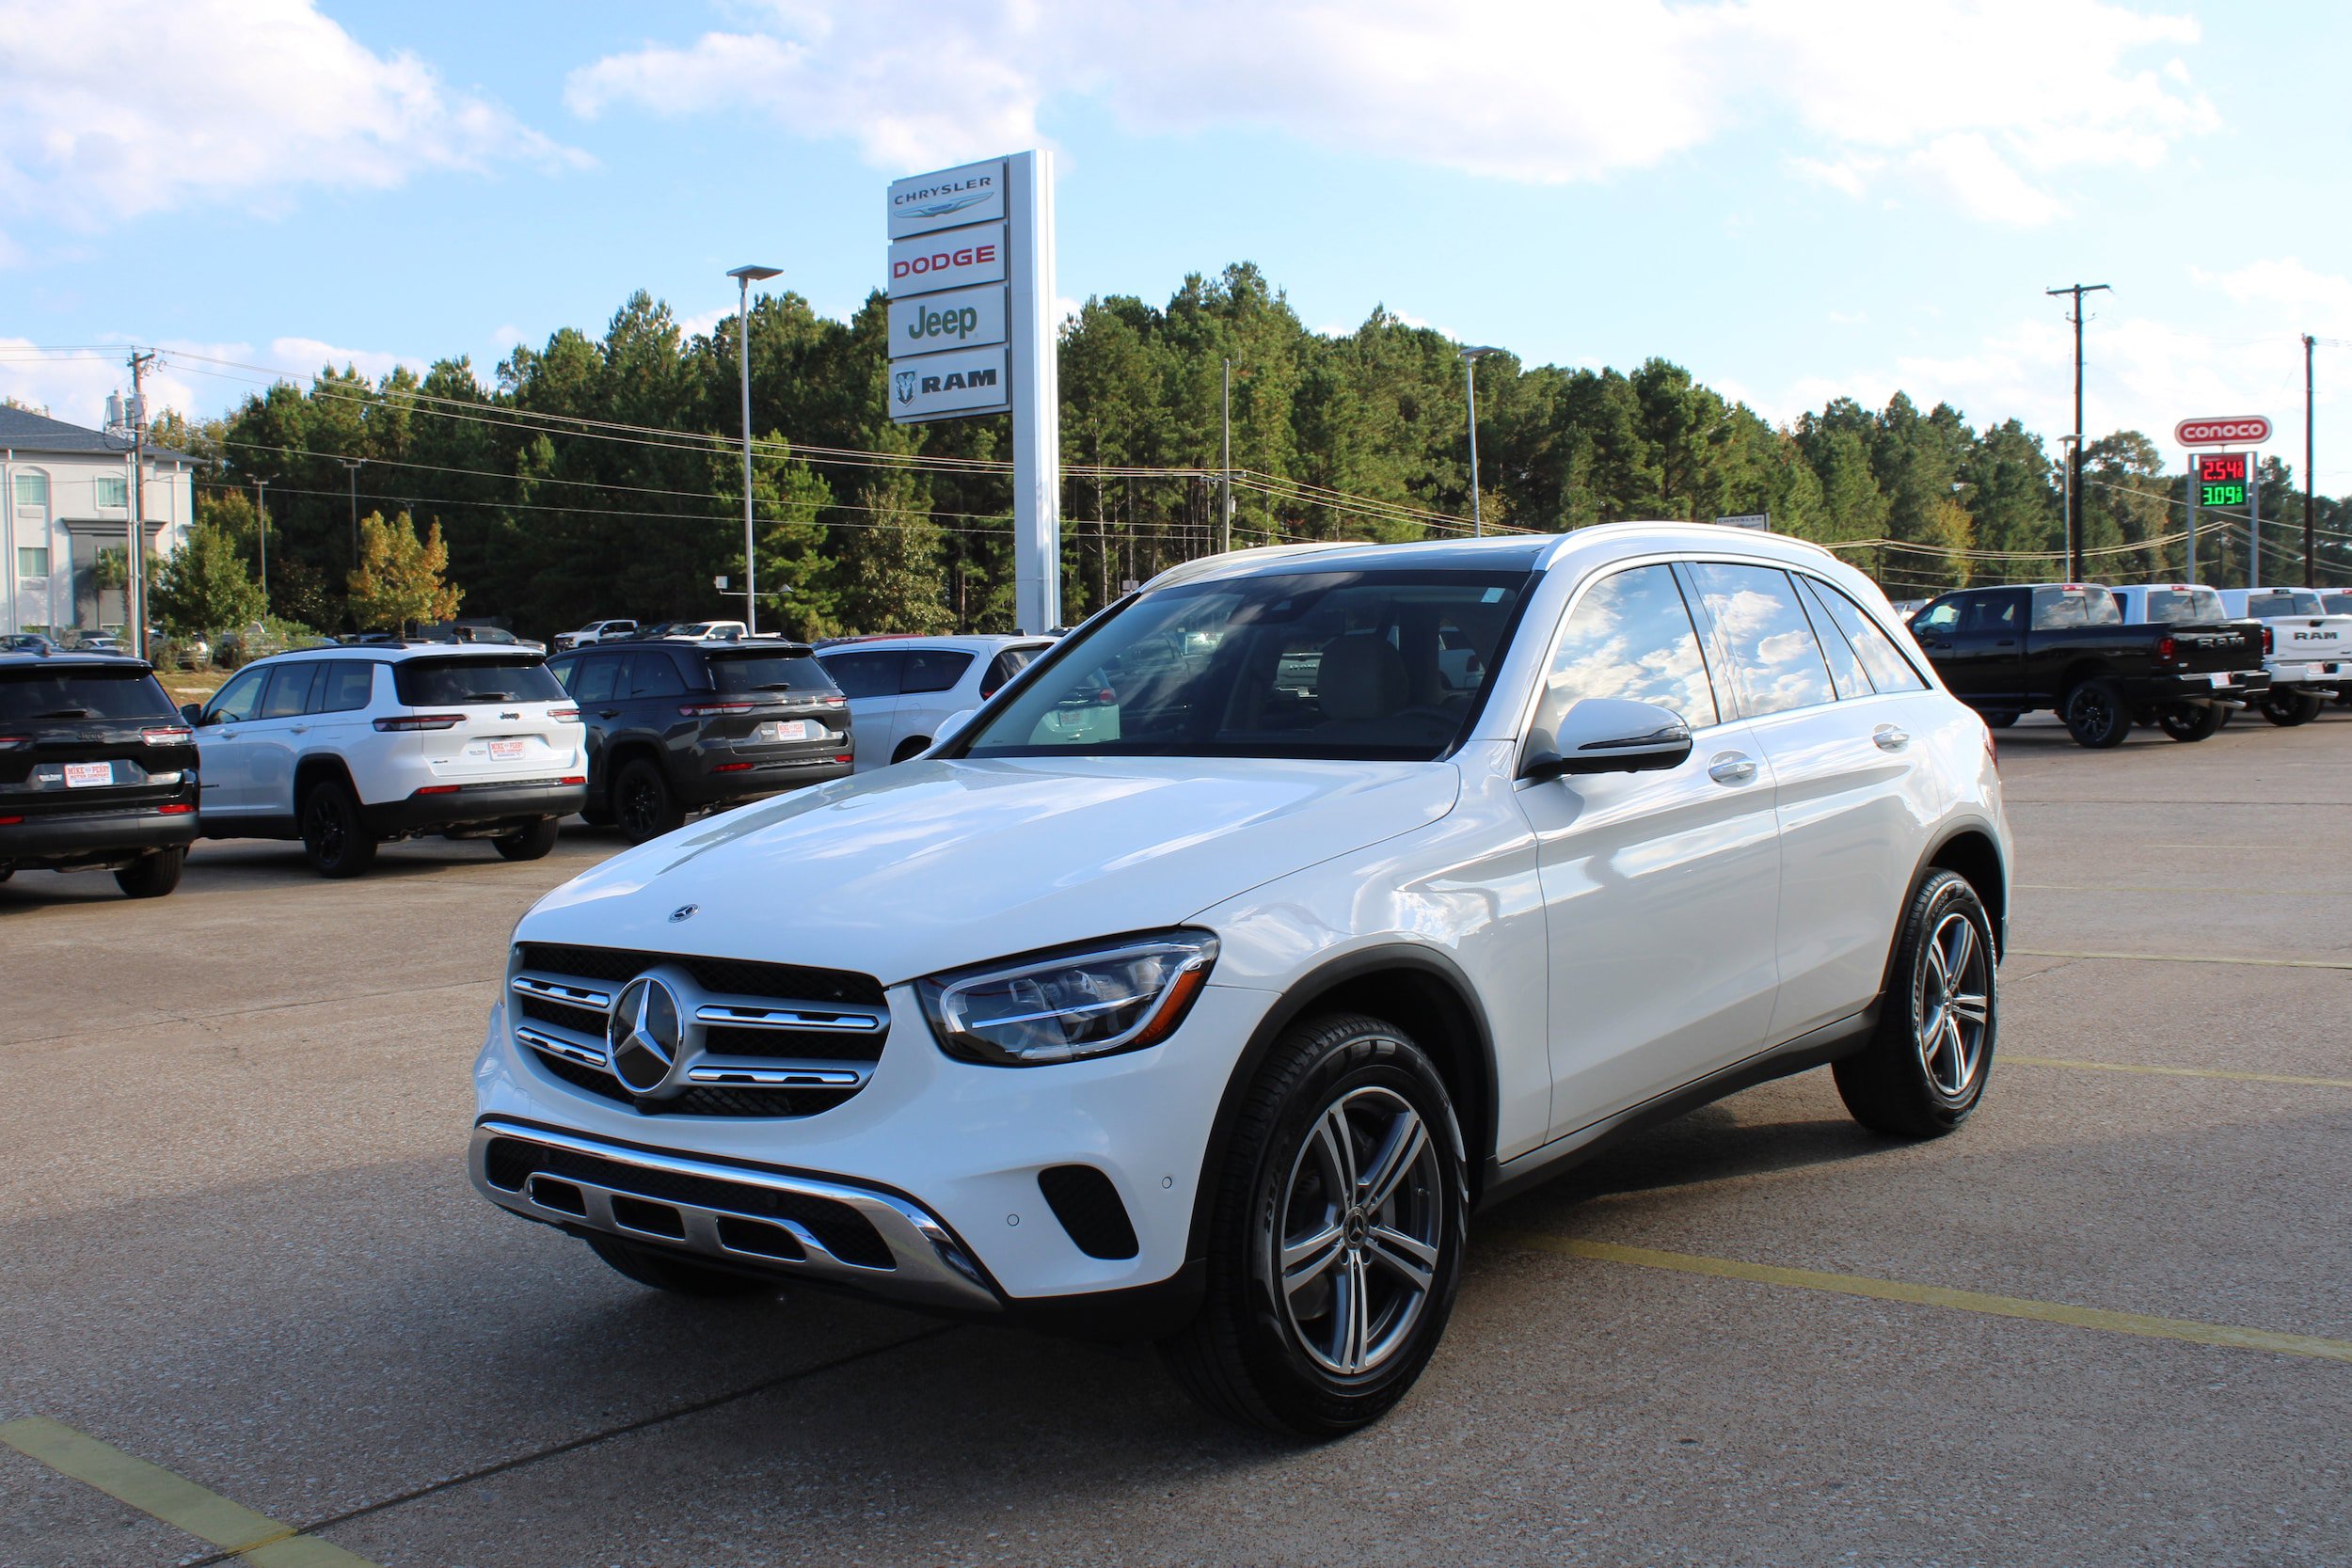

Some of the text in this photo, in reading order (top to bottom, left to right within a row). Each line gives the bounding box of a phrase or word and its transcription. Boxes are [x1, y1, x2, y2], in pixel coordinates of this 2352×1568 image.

[895, 177, 992, 205] CHRYSLER
[894, 245, 995, 278] DODGE
[909, 305, 977, 340] Jeep
[921, 368, 997, 394] RAM
[2198, 637, 2246, 648] RAM
[2295, 631, 2338, 641] RAM
[500, 712, 520, 721] Jeep
